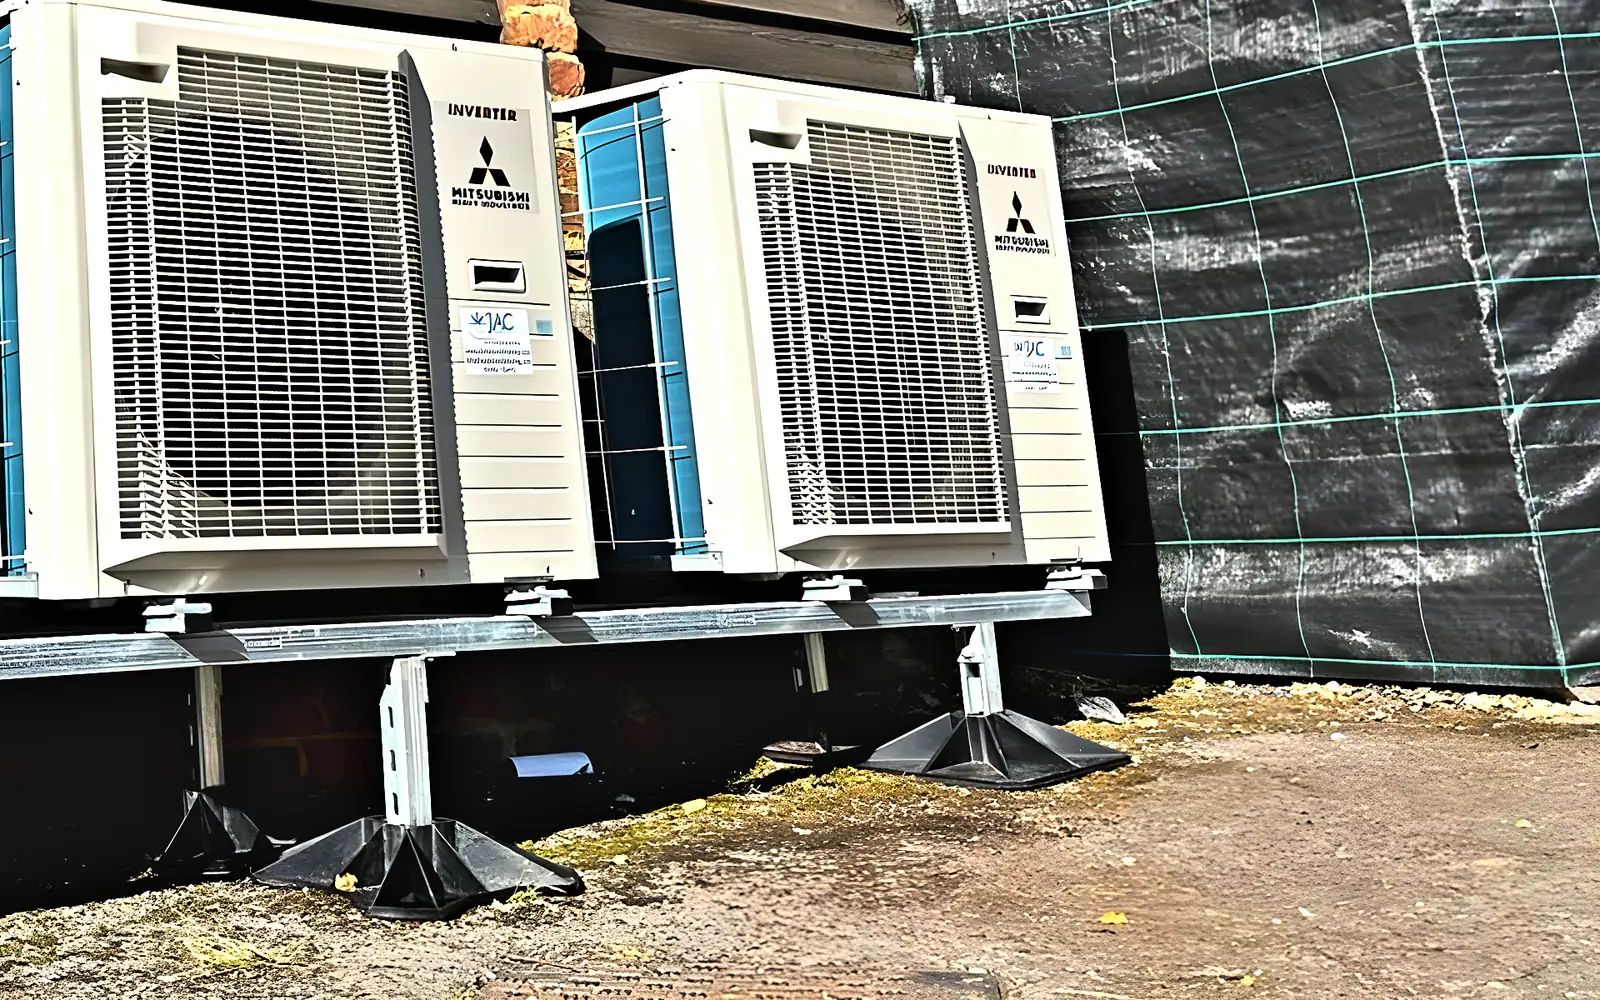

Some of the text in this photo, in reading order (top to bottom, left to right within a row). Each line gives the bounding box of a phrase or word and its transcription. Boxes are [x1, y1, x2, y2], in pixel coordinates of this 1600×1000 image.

[448, 103, 517, 121] INVERTER
[452, 187, 530, 203] MITSUBISHI
[484, 311, 515, 334] JAC
